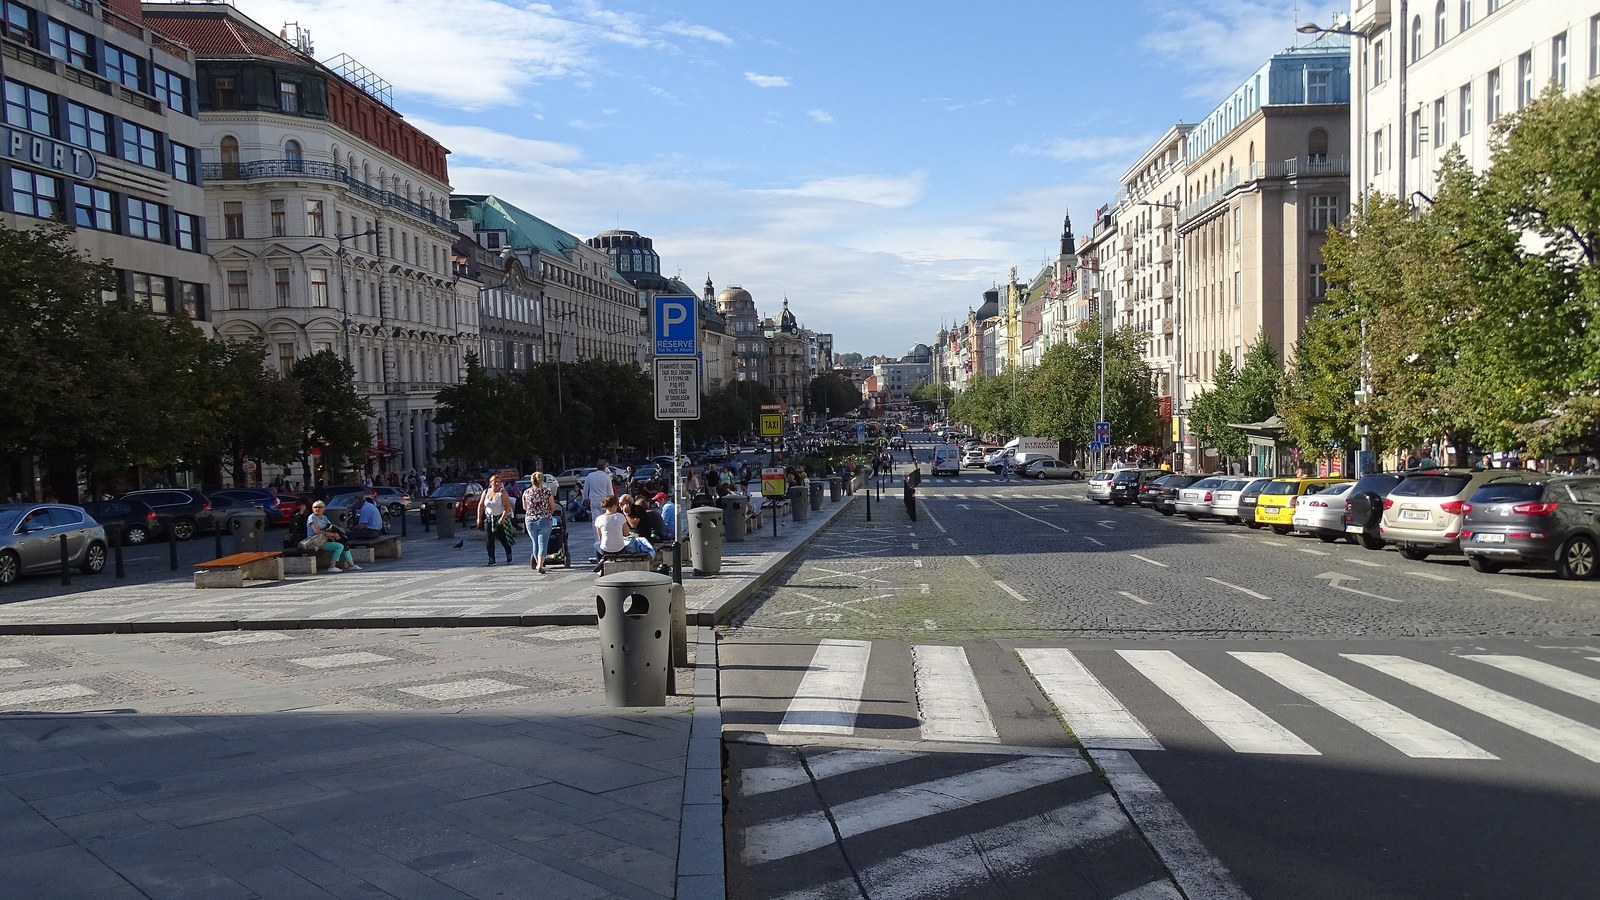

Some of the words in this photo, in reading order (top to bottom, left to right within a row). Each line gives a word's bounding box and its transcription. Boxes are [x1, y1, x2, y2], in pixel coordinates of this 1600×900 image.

[9, 130, 83, 173] PORT
[663, 303, 687, 337] P
[657, 339, 693, 348] RÉSERVÉ
[764, 420, 779, 429] TAXI
